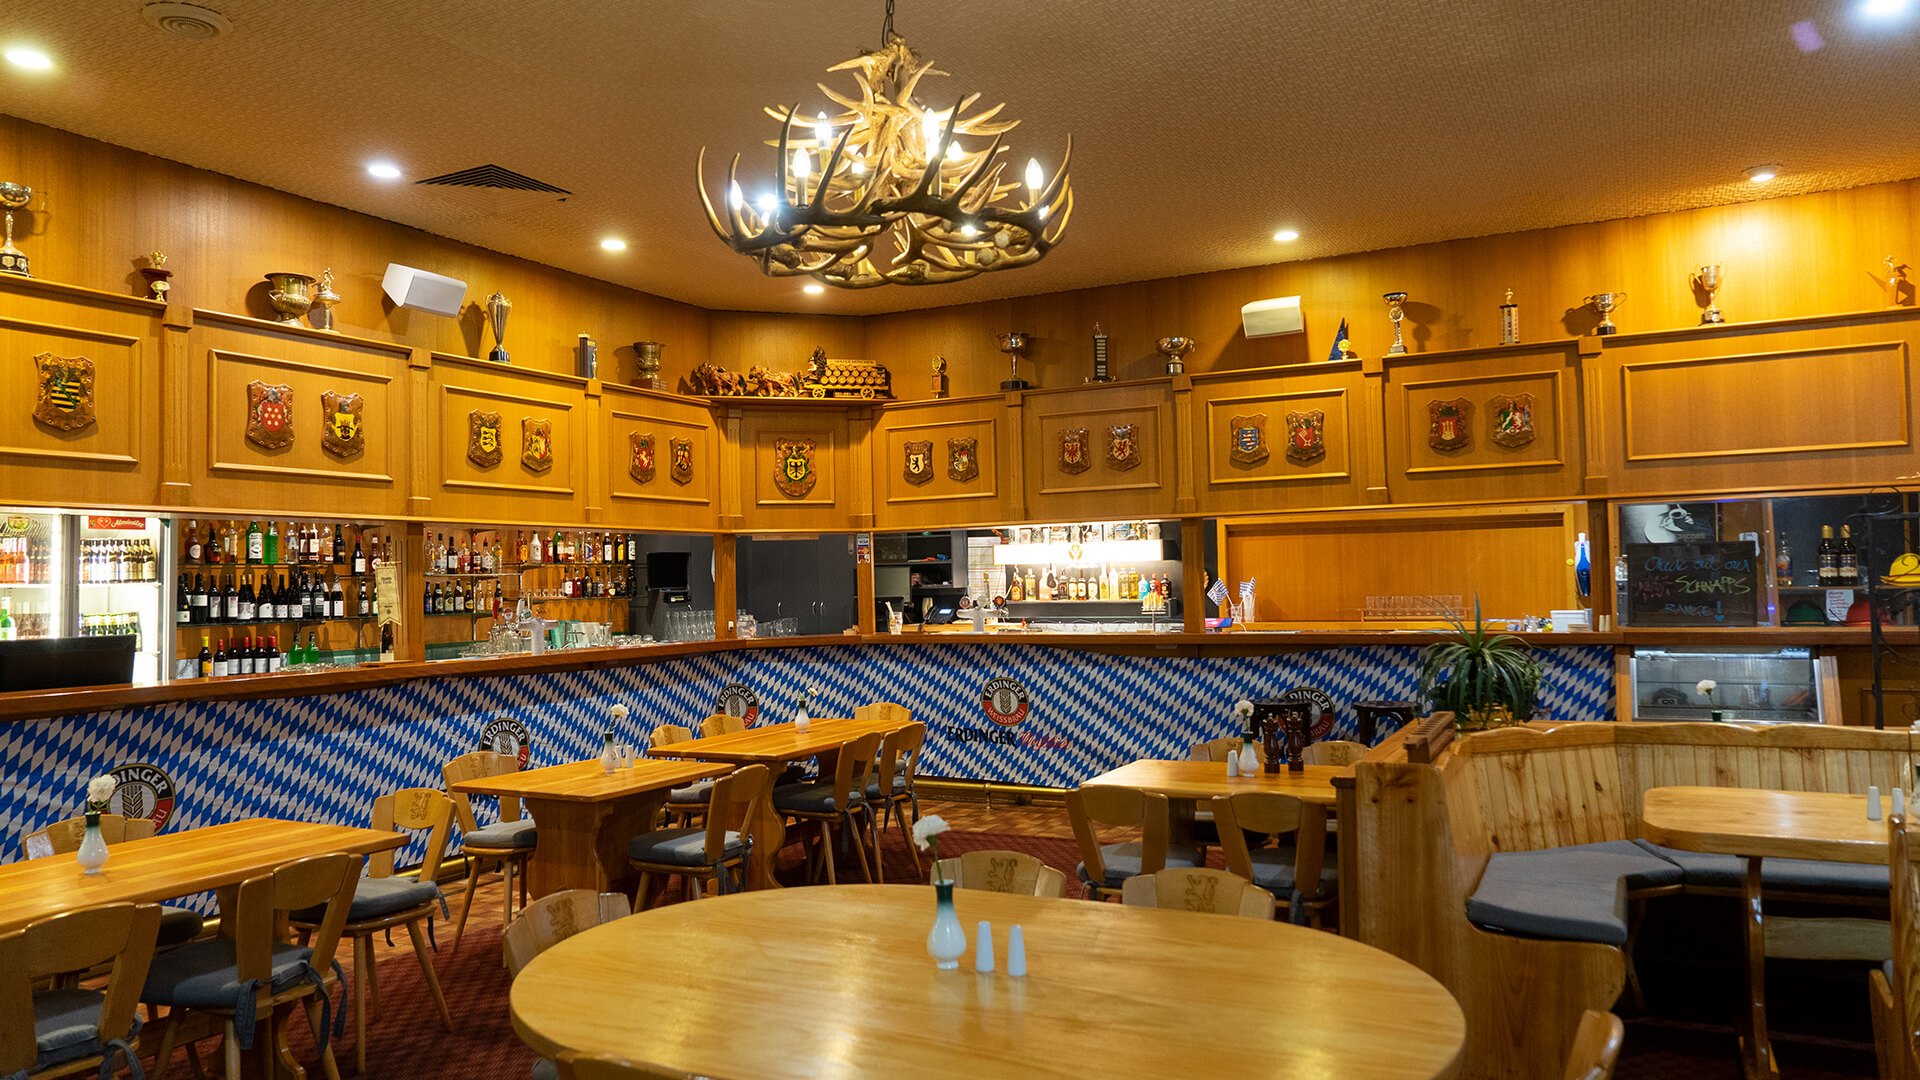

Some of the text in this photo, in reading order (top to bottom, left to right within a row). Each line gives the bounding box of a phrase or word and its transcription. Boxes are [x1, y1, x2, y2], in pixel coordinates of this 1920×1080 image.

[1675, 575, 1751, 595] SCHNAPPS
[719, 686, 755, 708] ERDINGER
[984, 680, 1025, 699] ERDINGER
[1289, 691, 1329, 710] DINGER
[483, 721, 526, 746] ERDINGER
[947, 726, 1016, 747] ERDINGER
[112, 768, 168, 793] DINGER
